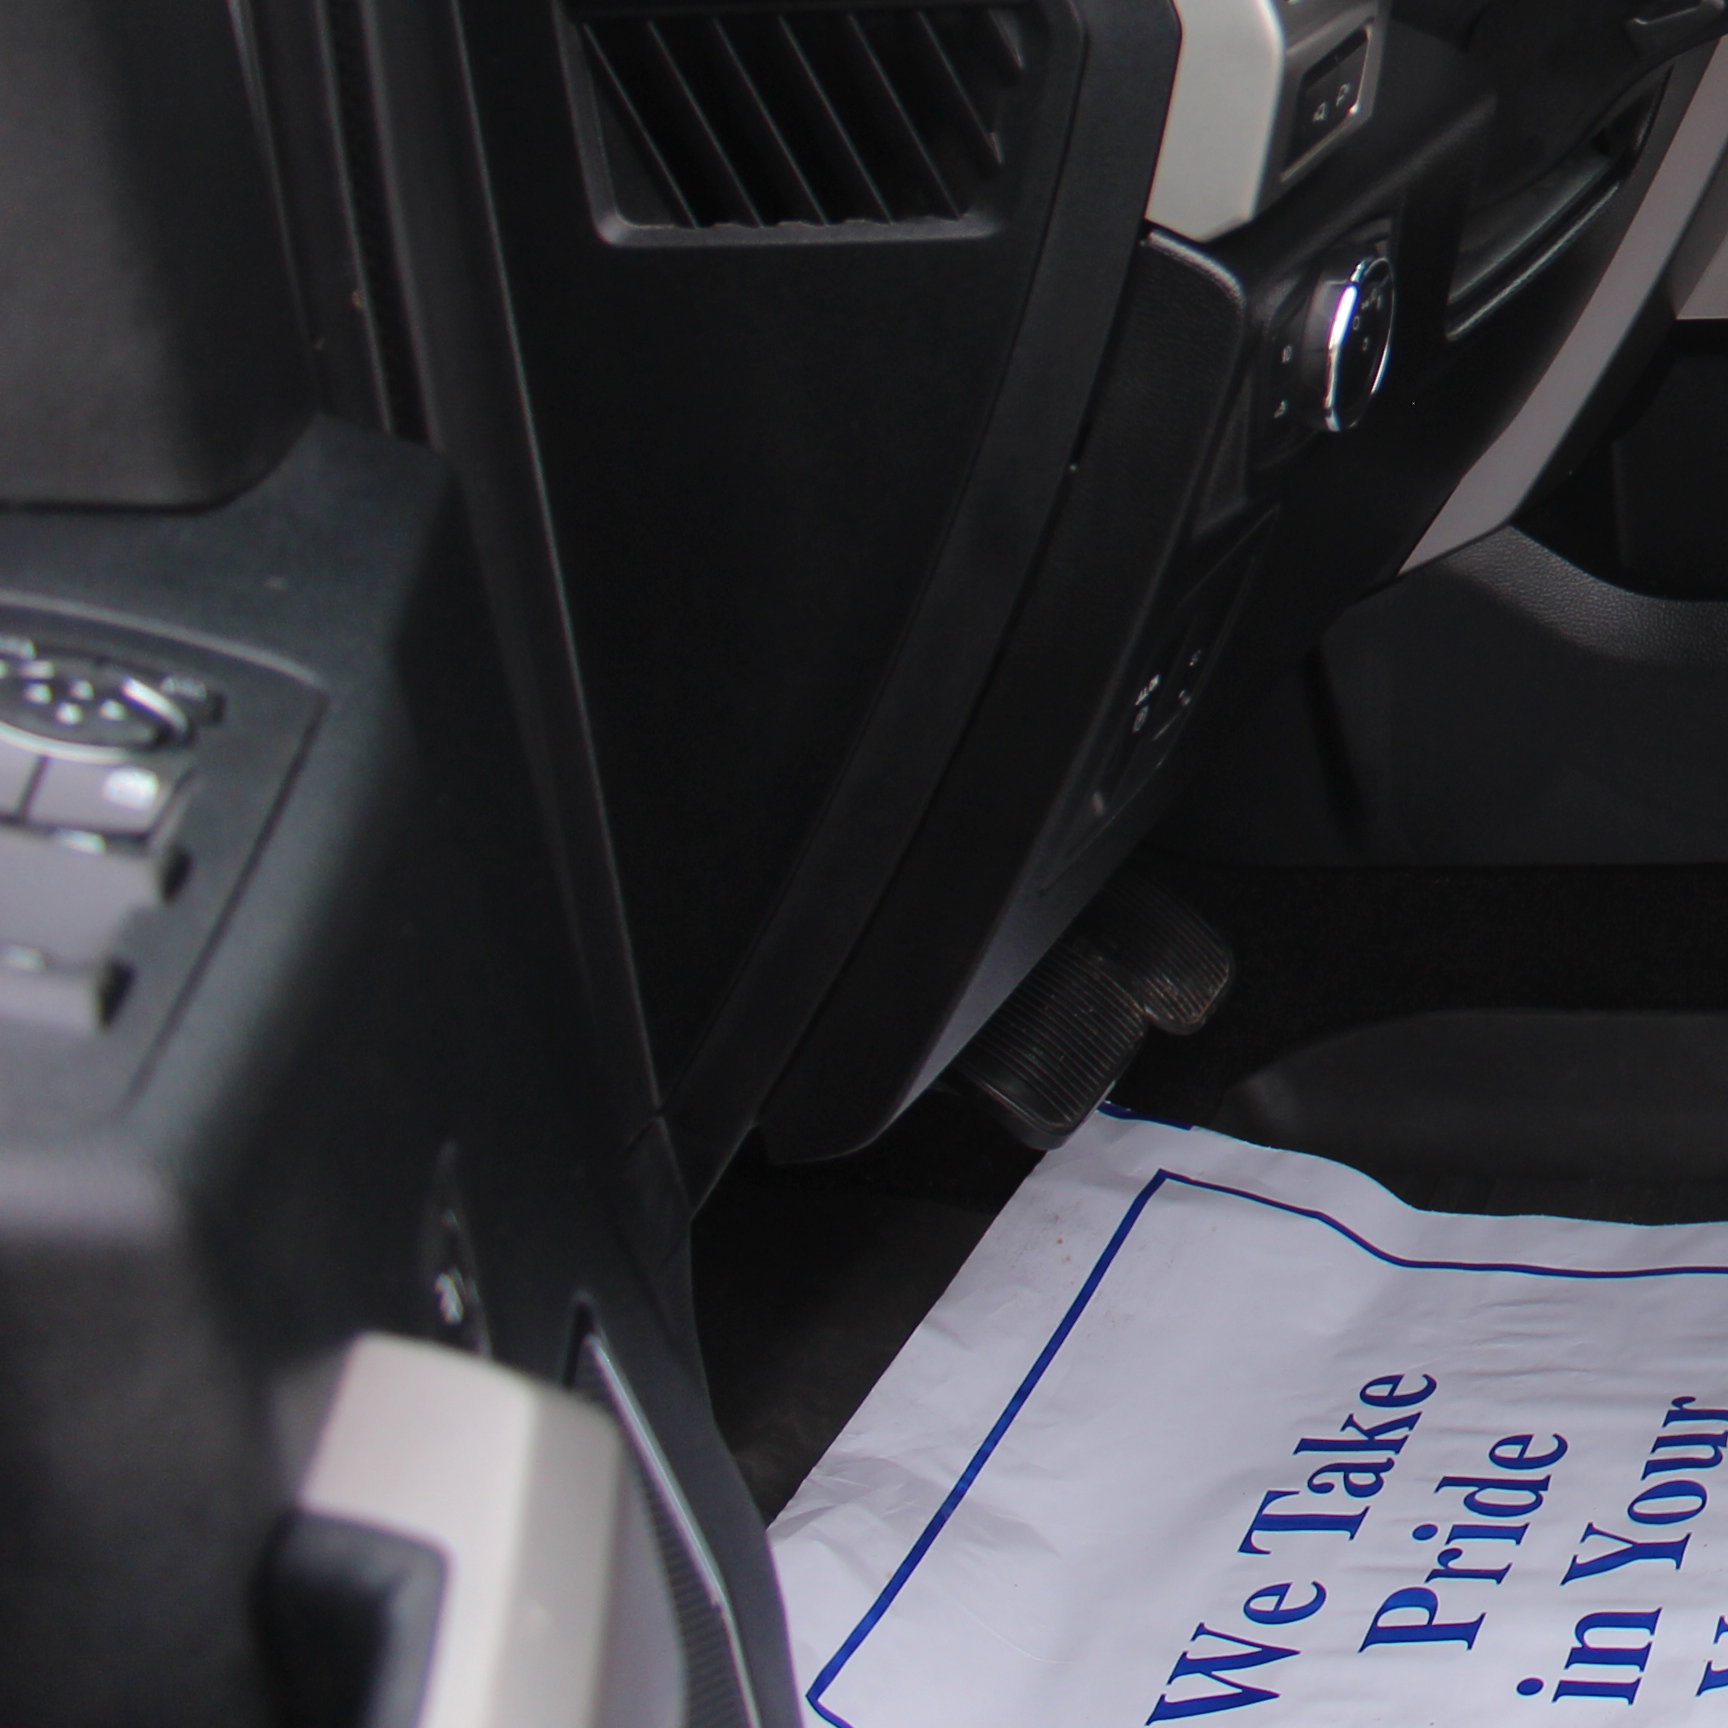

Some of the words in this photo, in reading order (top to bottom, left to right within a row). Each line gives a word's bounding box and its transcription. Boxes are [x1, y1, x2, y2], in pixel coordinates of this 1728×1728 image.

[1144, 1580, 1327, 1726] We
[1237, 1373, 1438, 1555] Take
[1358, 1433, 1568, 1653] Pride
[1516, 1607, 1663, 1706] in
